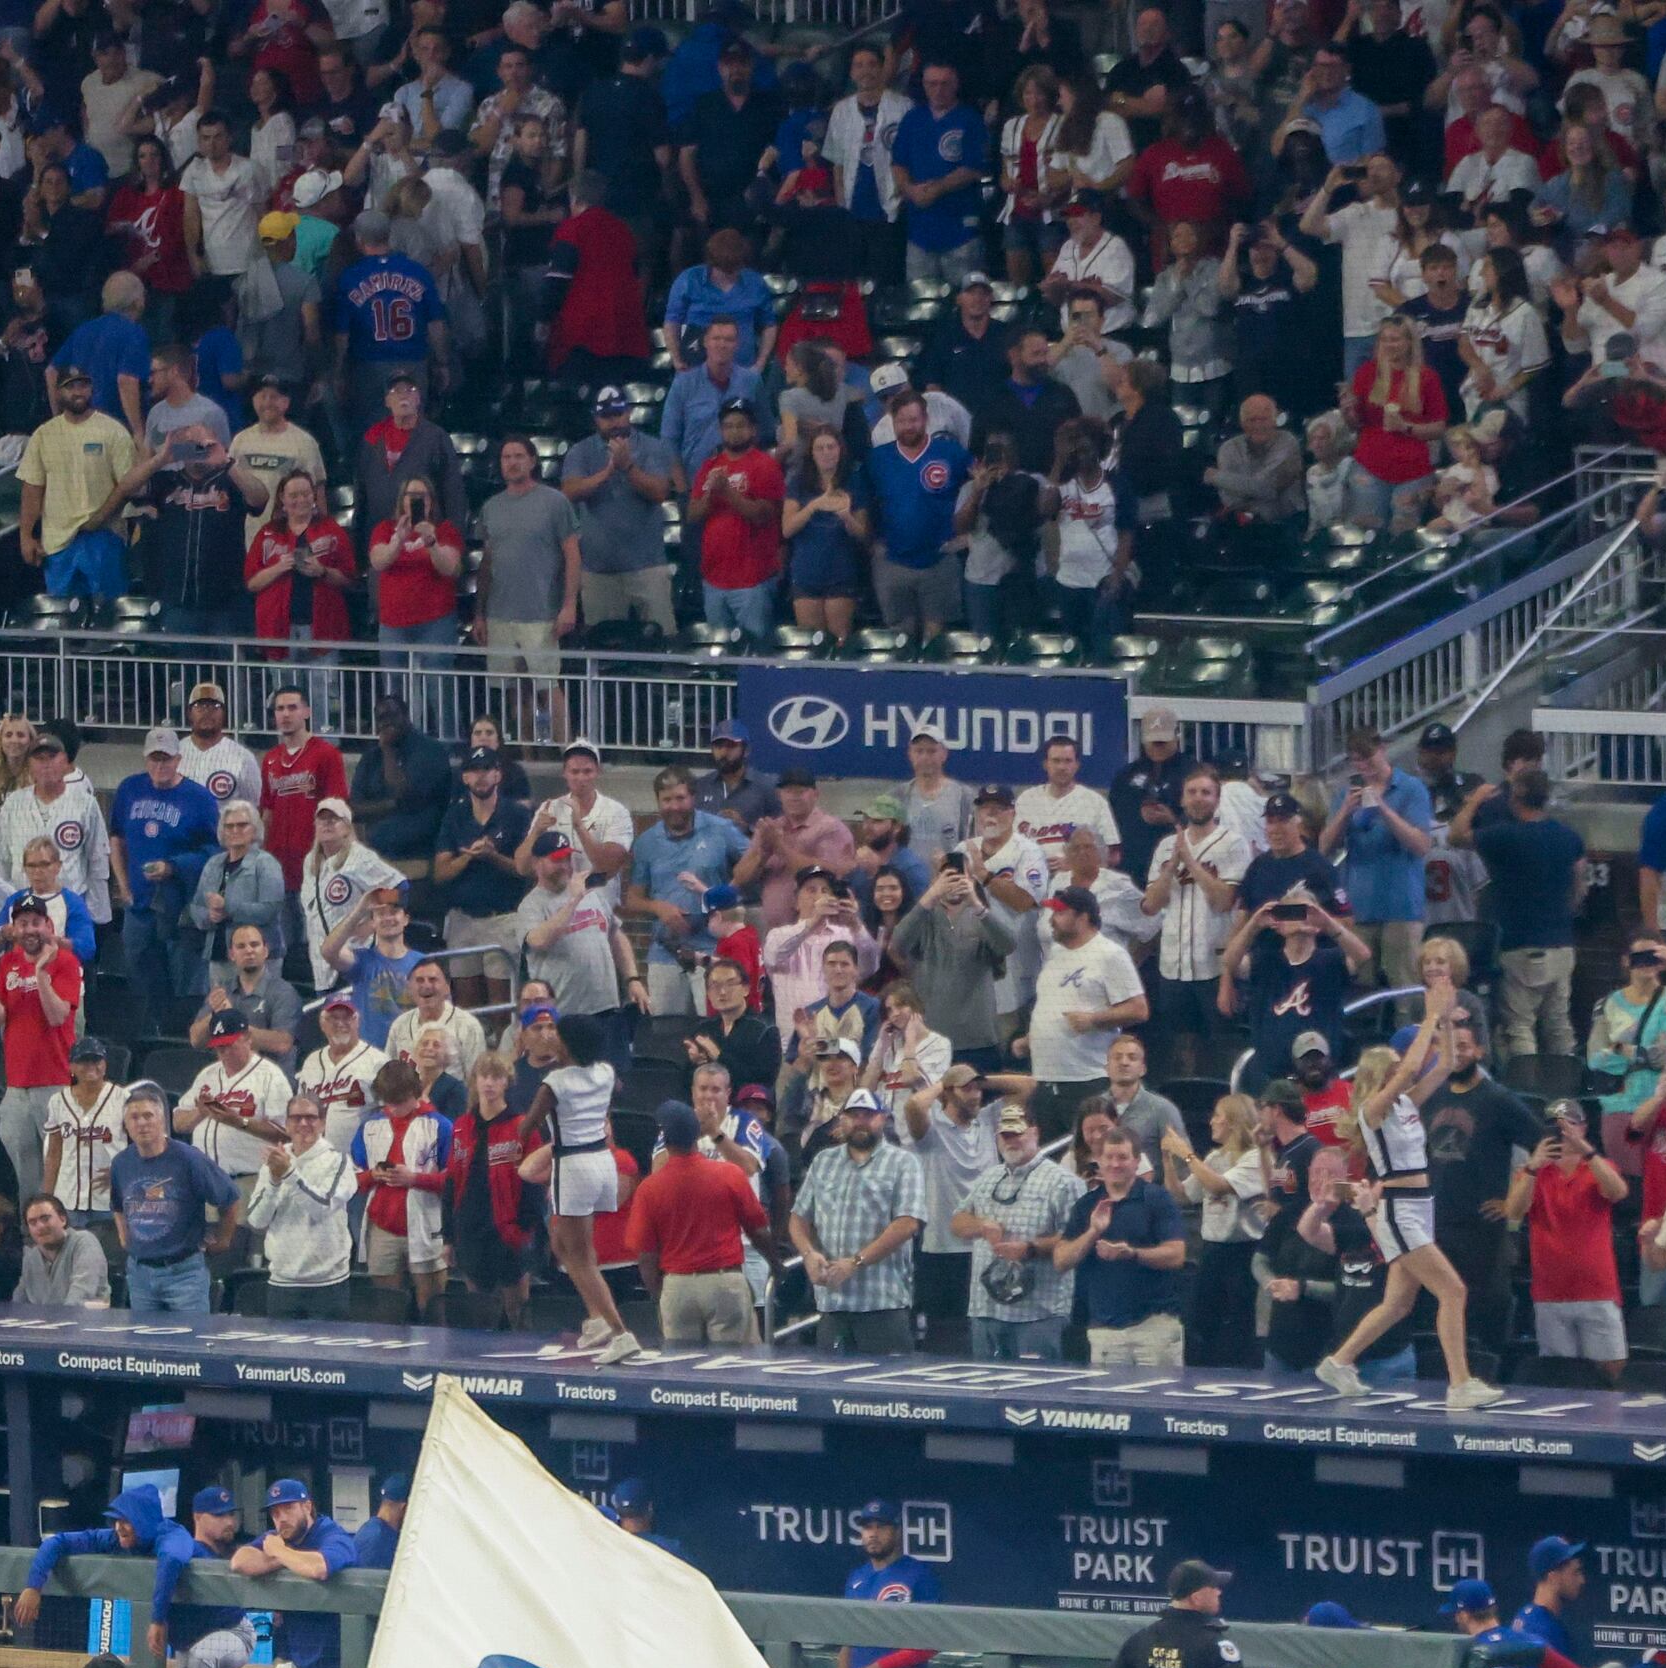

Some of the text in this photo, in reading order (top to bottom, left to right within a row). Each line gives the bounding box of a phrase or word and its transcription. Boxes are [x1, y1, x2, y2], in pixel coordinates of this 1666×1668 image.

[372, 299, 414, 342] 16
[865, 706, 1093, 757] HYUNDAI
[81, 1324, 195, 1336] OF
[197, 1331, 428, 1350] HOME
[58, 1352, 123, 1373] Compact
[125, 1355, 201, 1378] Equipment
[235, 1364, 347, 1385] YanmarUS.com
[555, 1382, 617, 1402] Tractors
[650, 1387, 718, 1410] Compact
[719, 1390, 799, 1413] Equipment
[831, 1398, 946, 1421] YanmarUS.com
[1039, 1408, 1573, 1457] YANMAR Tractors Compact Equipment YanmarUS.com
[751, 1504, 866, 1547] TRUIS
[1062, 1513, 1169, 1549] TRUIST
[1073, 1552, 1155, 1585] PARK
[1277, 1532, 1423, 1578] TRUIST
[1058, 1597, 1089, 1609] HOME
[1092, 1599, 1106, 1610] OF
[1109, 1600, 1131, 1611] THE
